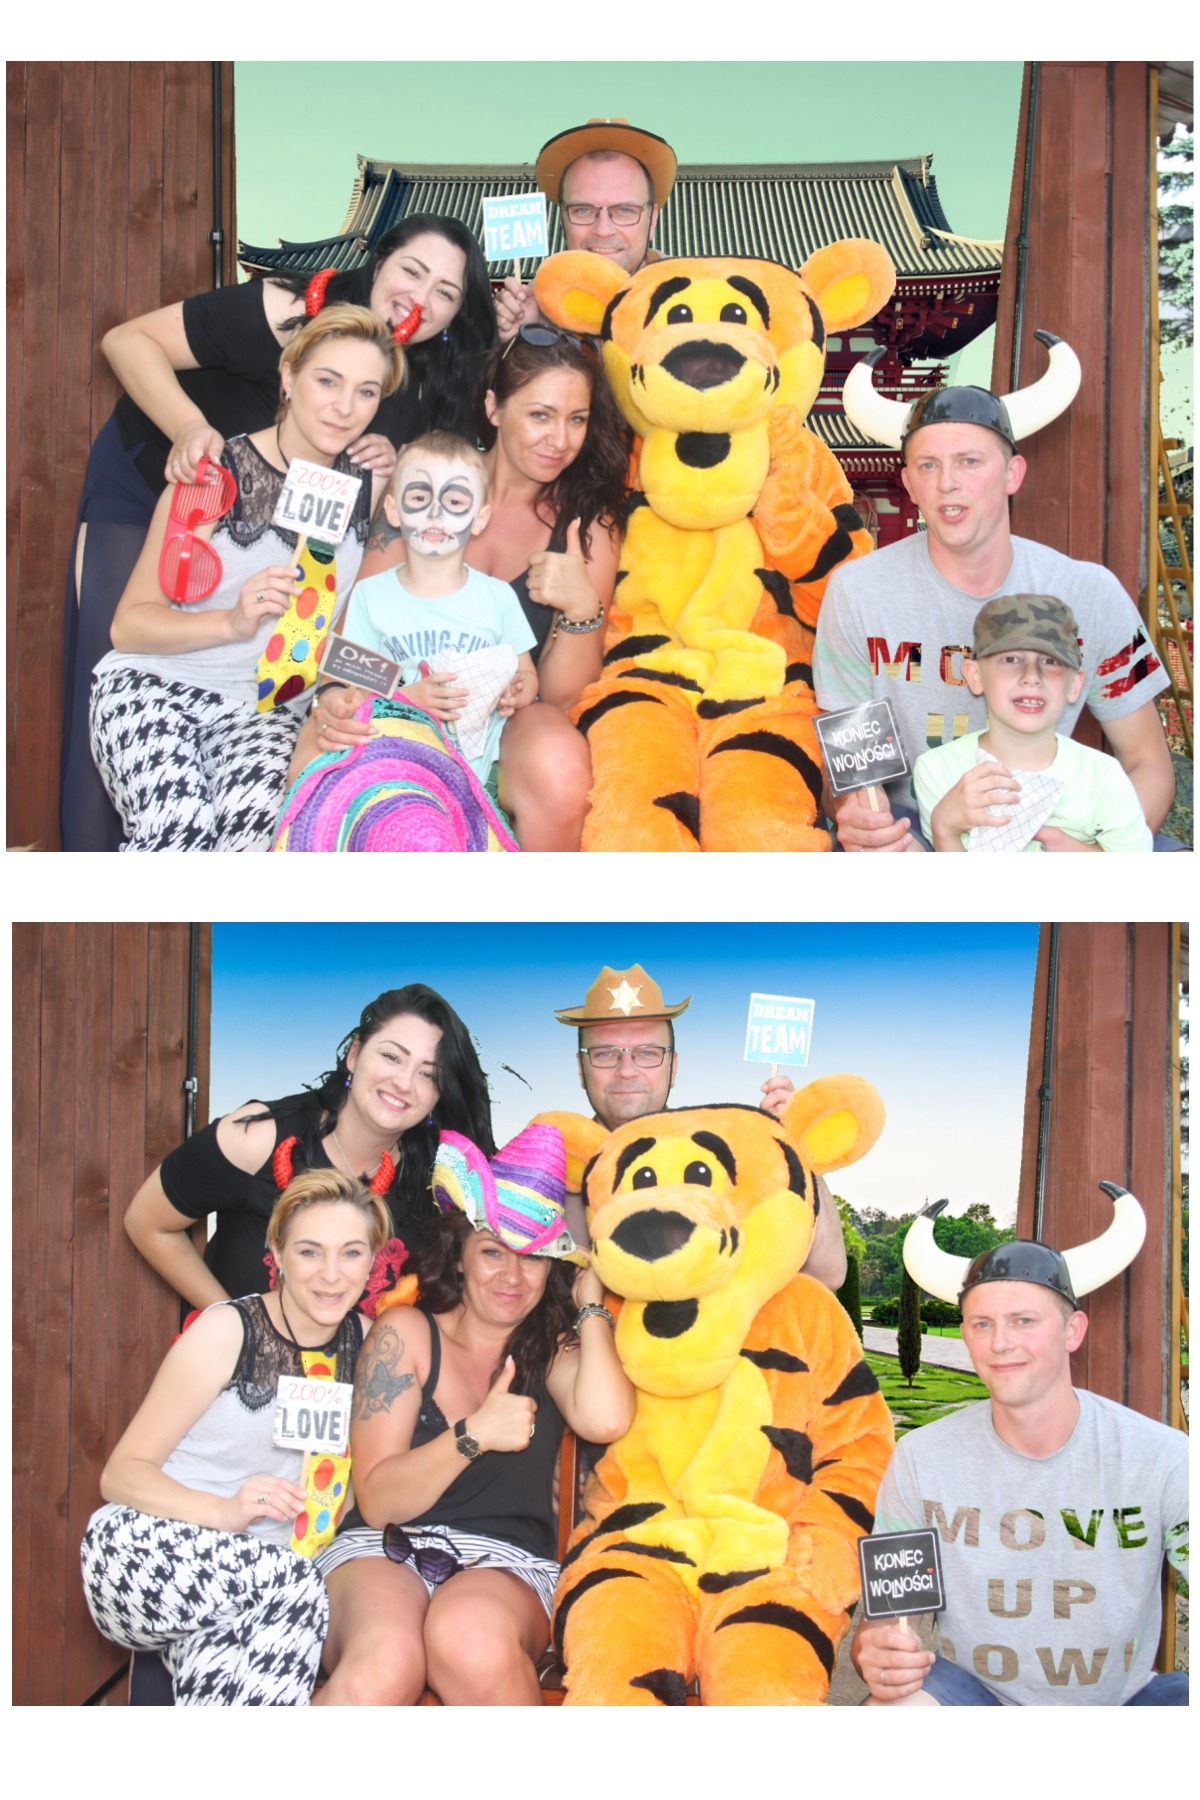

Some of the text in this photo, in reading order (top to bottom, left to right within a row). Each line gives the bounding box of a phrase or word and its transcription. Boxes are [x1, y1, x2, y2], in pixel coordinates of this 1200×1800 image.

[487, 202, 542, 219] DREAM
[488, 219, 544, 252] TEAM
[298, 466, 351, 496] 200%
[339, 646, 388, 673] OK!
[384, 629, 490, 662] HAVING FU
[832, 720, 881, 746] KONIEC
[832, 739, 896, 773] WOLNOŚCI
[753, 1003, 809, 1022] DREAM
[751, 1024, 807, 1055] TEAM
[288, 1382, 342, 1406] 200%
[922, 1499, 1148, 1550] MOVE
[874, 1549, 924, 1571] KONIEC
[870, 1569, 934, 1598] WOLNOŚCI
[987, 1578, 1097, 1619] UP
